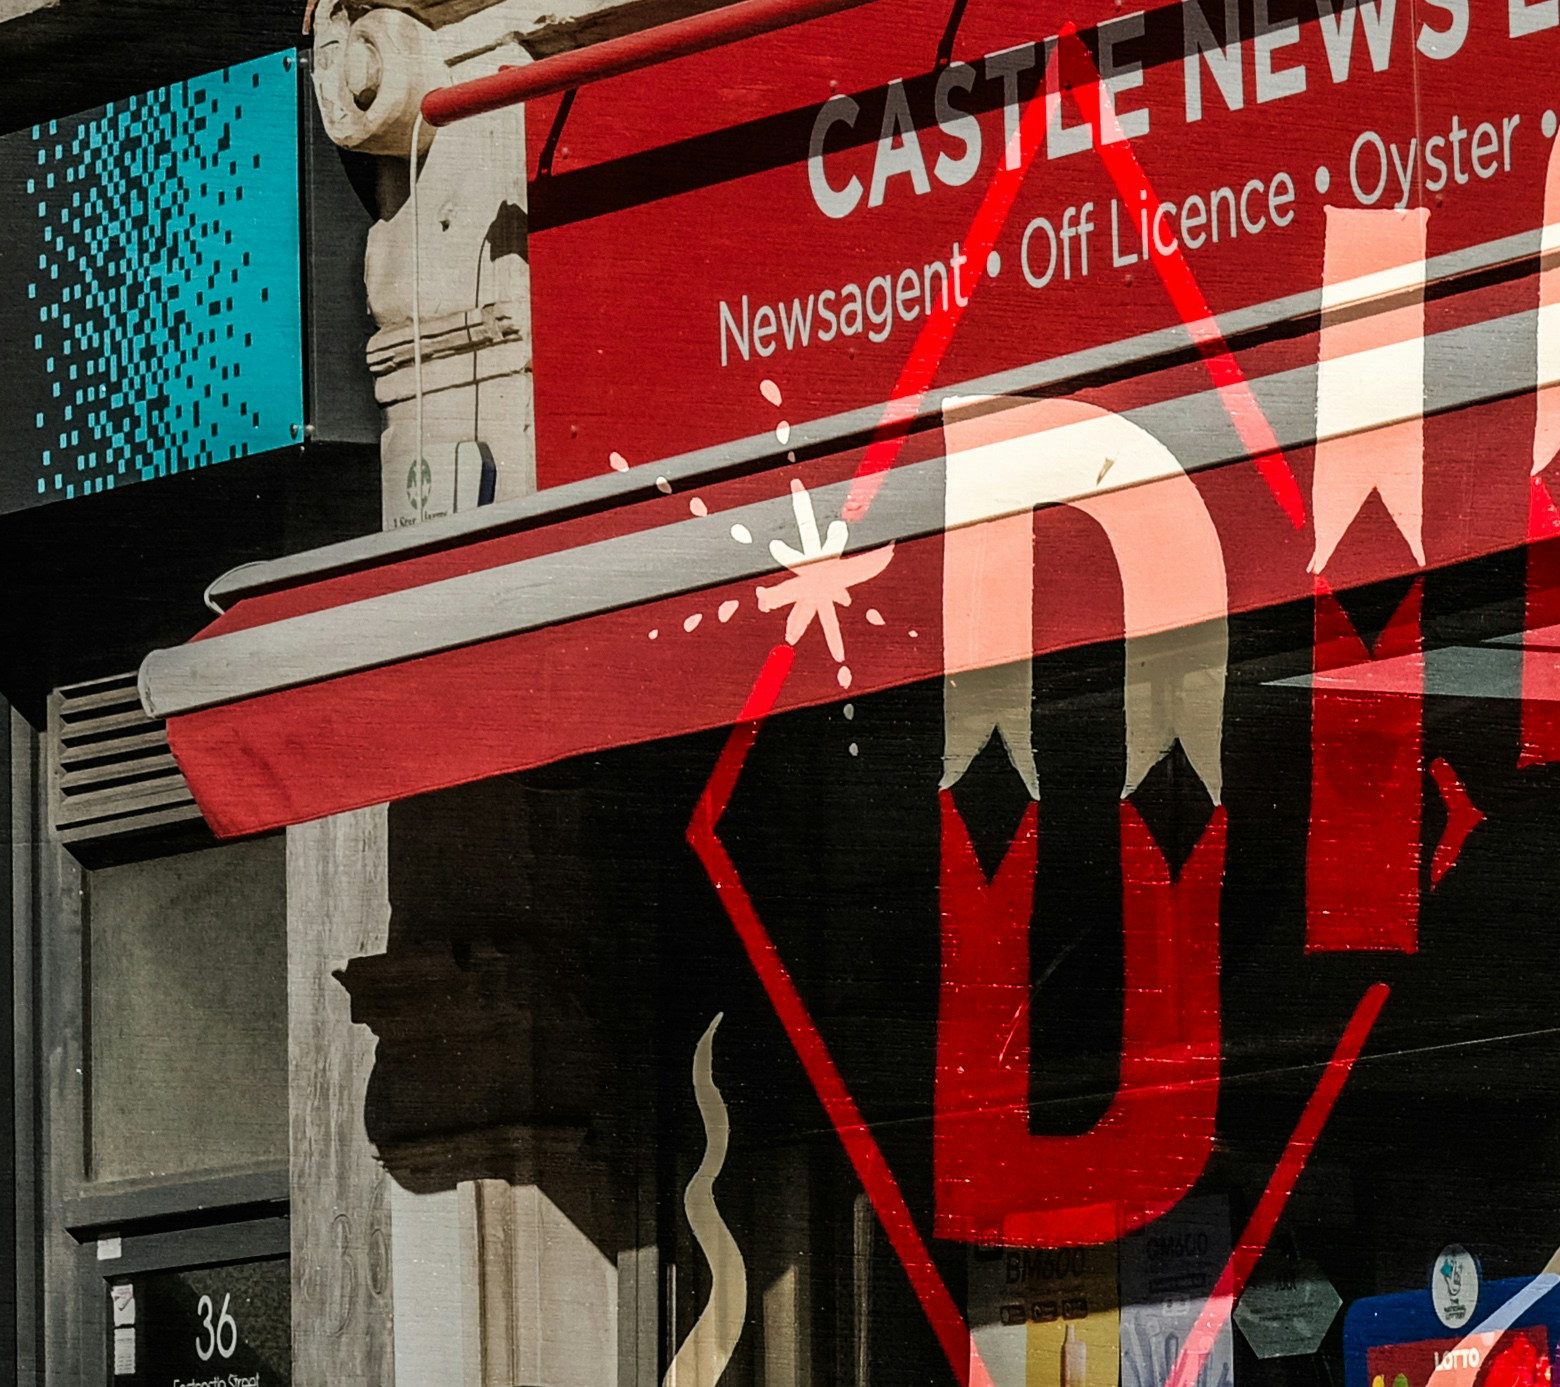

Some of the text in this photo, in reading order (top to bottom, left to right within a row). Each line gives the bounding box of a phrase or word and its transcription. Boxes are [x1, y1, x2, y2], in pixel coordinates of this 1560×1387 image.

[806, 7, 1150, 219] CASTLE
[718, 115, 1521, 367] Newsagent Off Licence Oyster
[195, 1292, 238, 1362] 36
[1434, 1348, 1480, 1372] LOTTO
